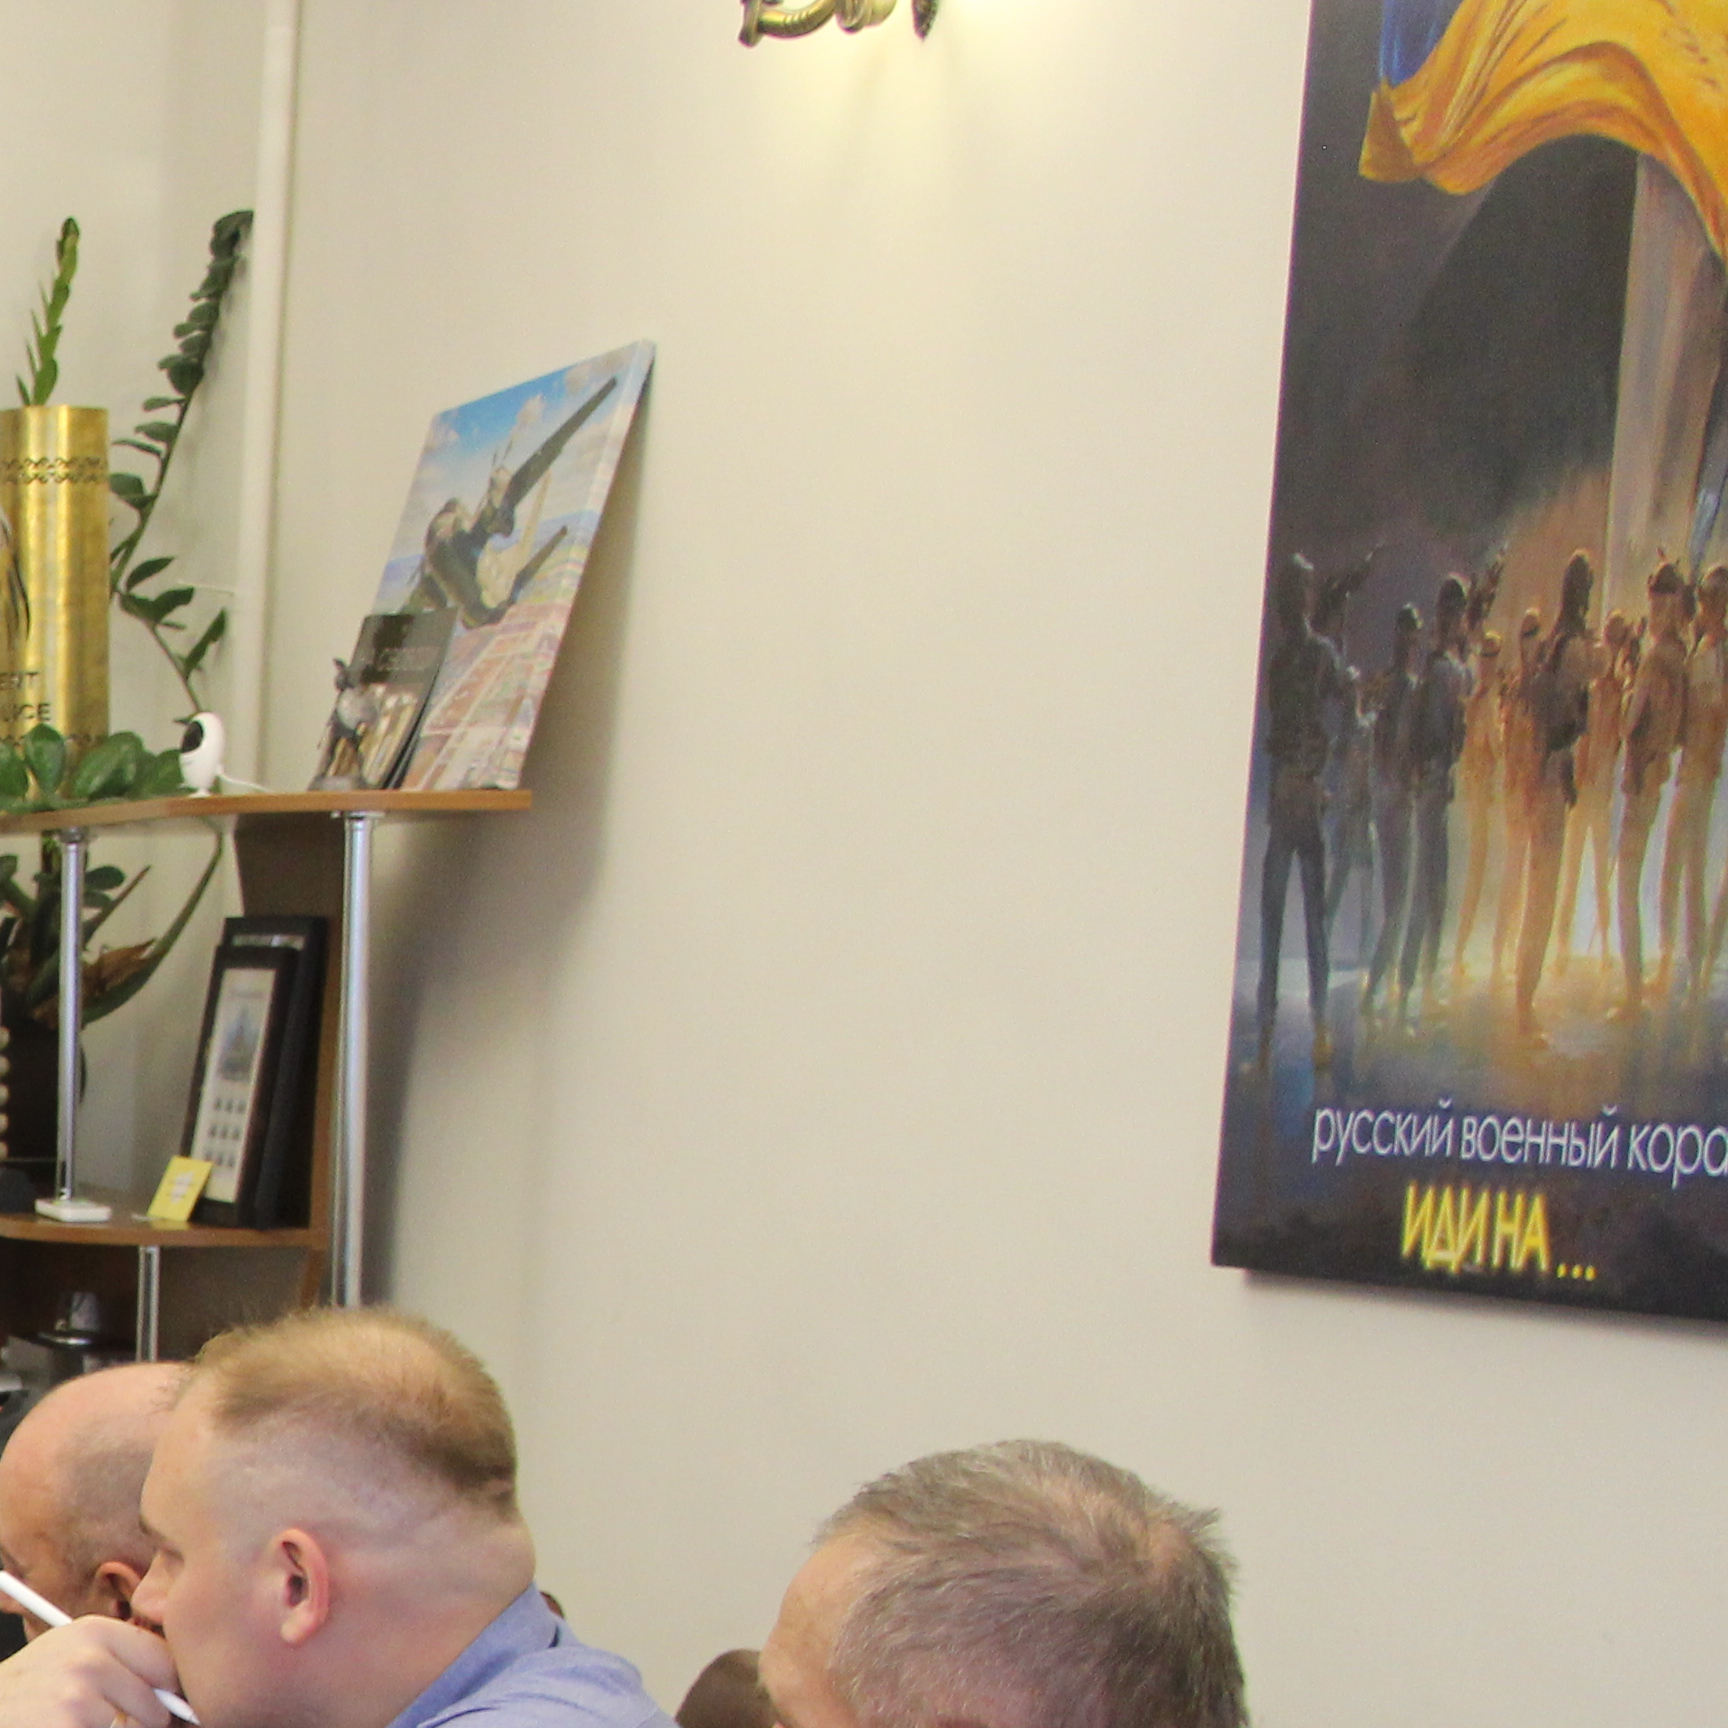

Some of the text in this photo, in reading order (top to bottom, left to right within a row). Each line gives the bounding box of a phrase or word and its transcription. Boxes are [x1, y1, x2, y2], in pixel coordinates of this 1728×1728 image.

[1312, 1099, 1454, 1166] русский
[1461, 1104, 1620, 1168] военный
[1402, 1182, 1490, 1274] ИДИ
